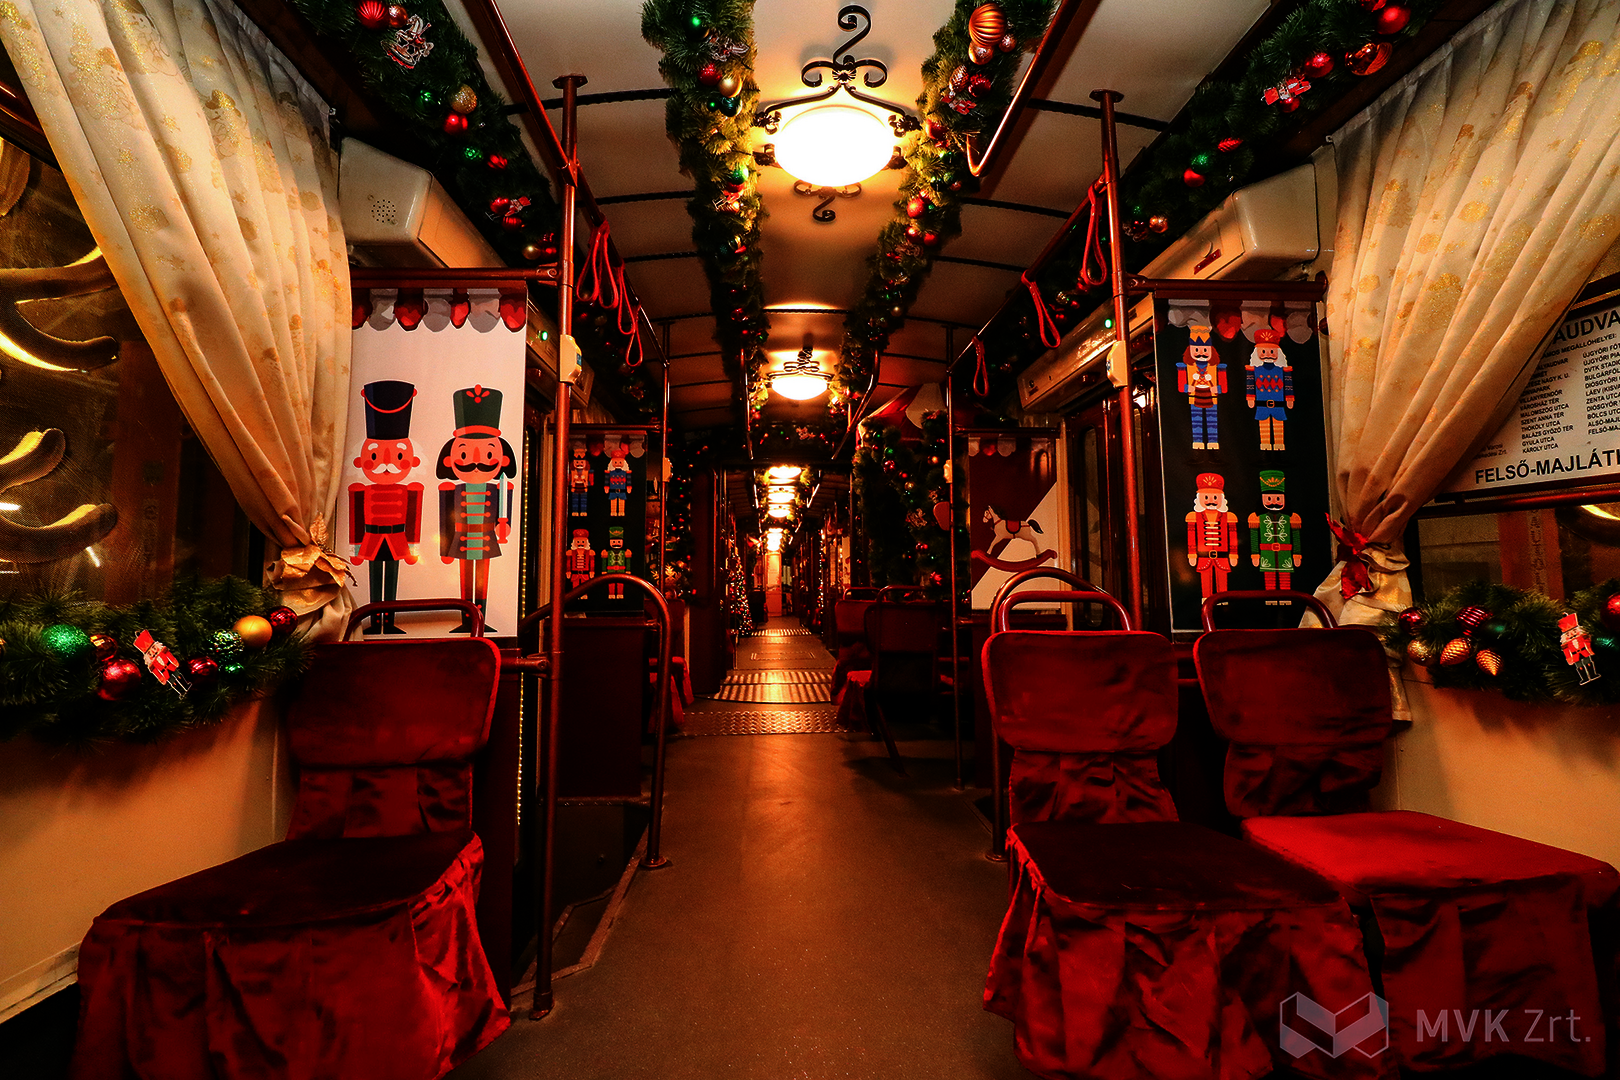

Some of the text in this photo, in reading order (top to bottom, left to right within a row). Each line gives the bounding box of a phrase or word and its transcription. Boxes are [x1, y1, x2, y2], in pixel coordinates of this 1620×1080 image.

[1584, 365, 1600, 373] DVTK
[1586, 395, 1605, 404] ZENTA
[1554, 403, 1569, 412] UTCA
[1521, 417, 1537, 425] SZENT
[1537, 414, 1552, 422] ANNA
[1545, 420, 1560, 428] UTCA
[1522, 436, 1554, 447] GYULA UTCA
[1544, 443, 1558, 451] UTCA
